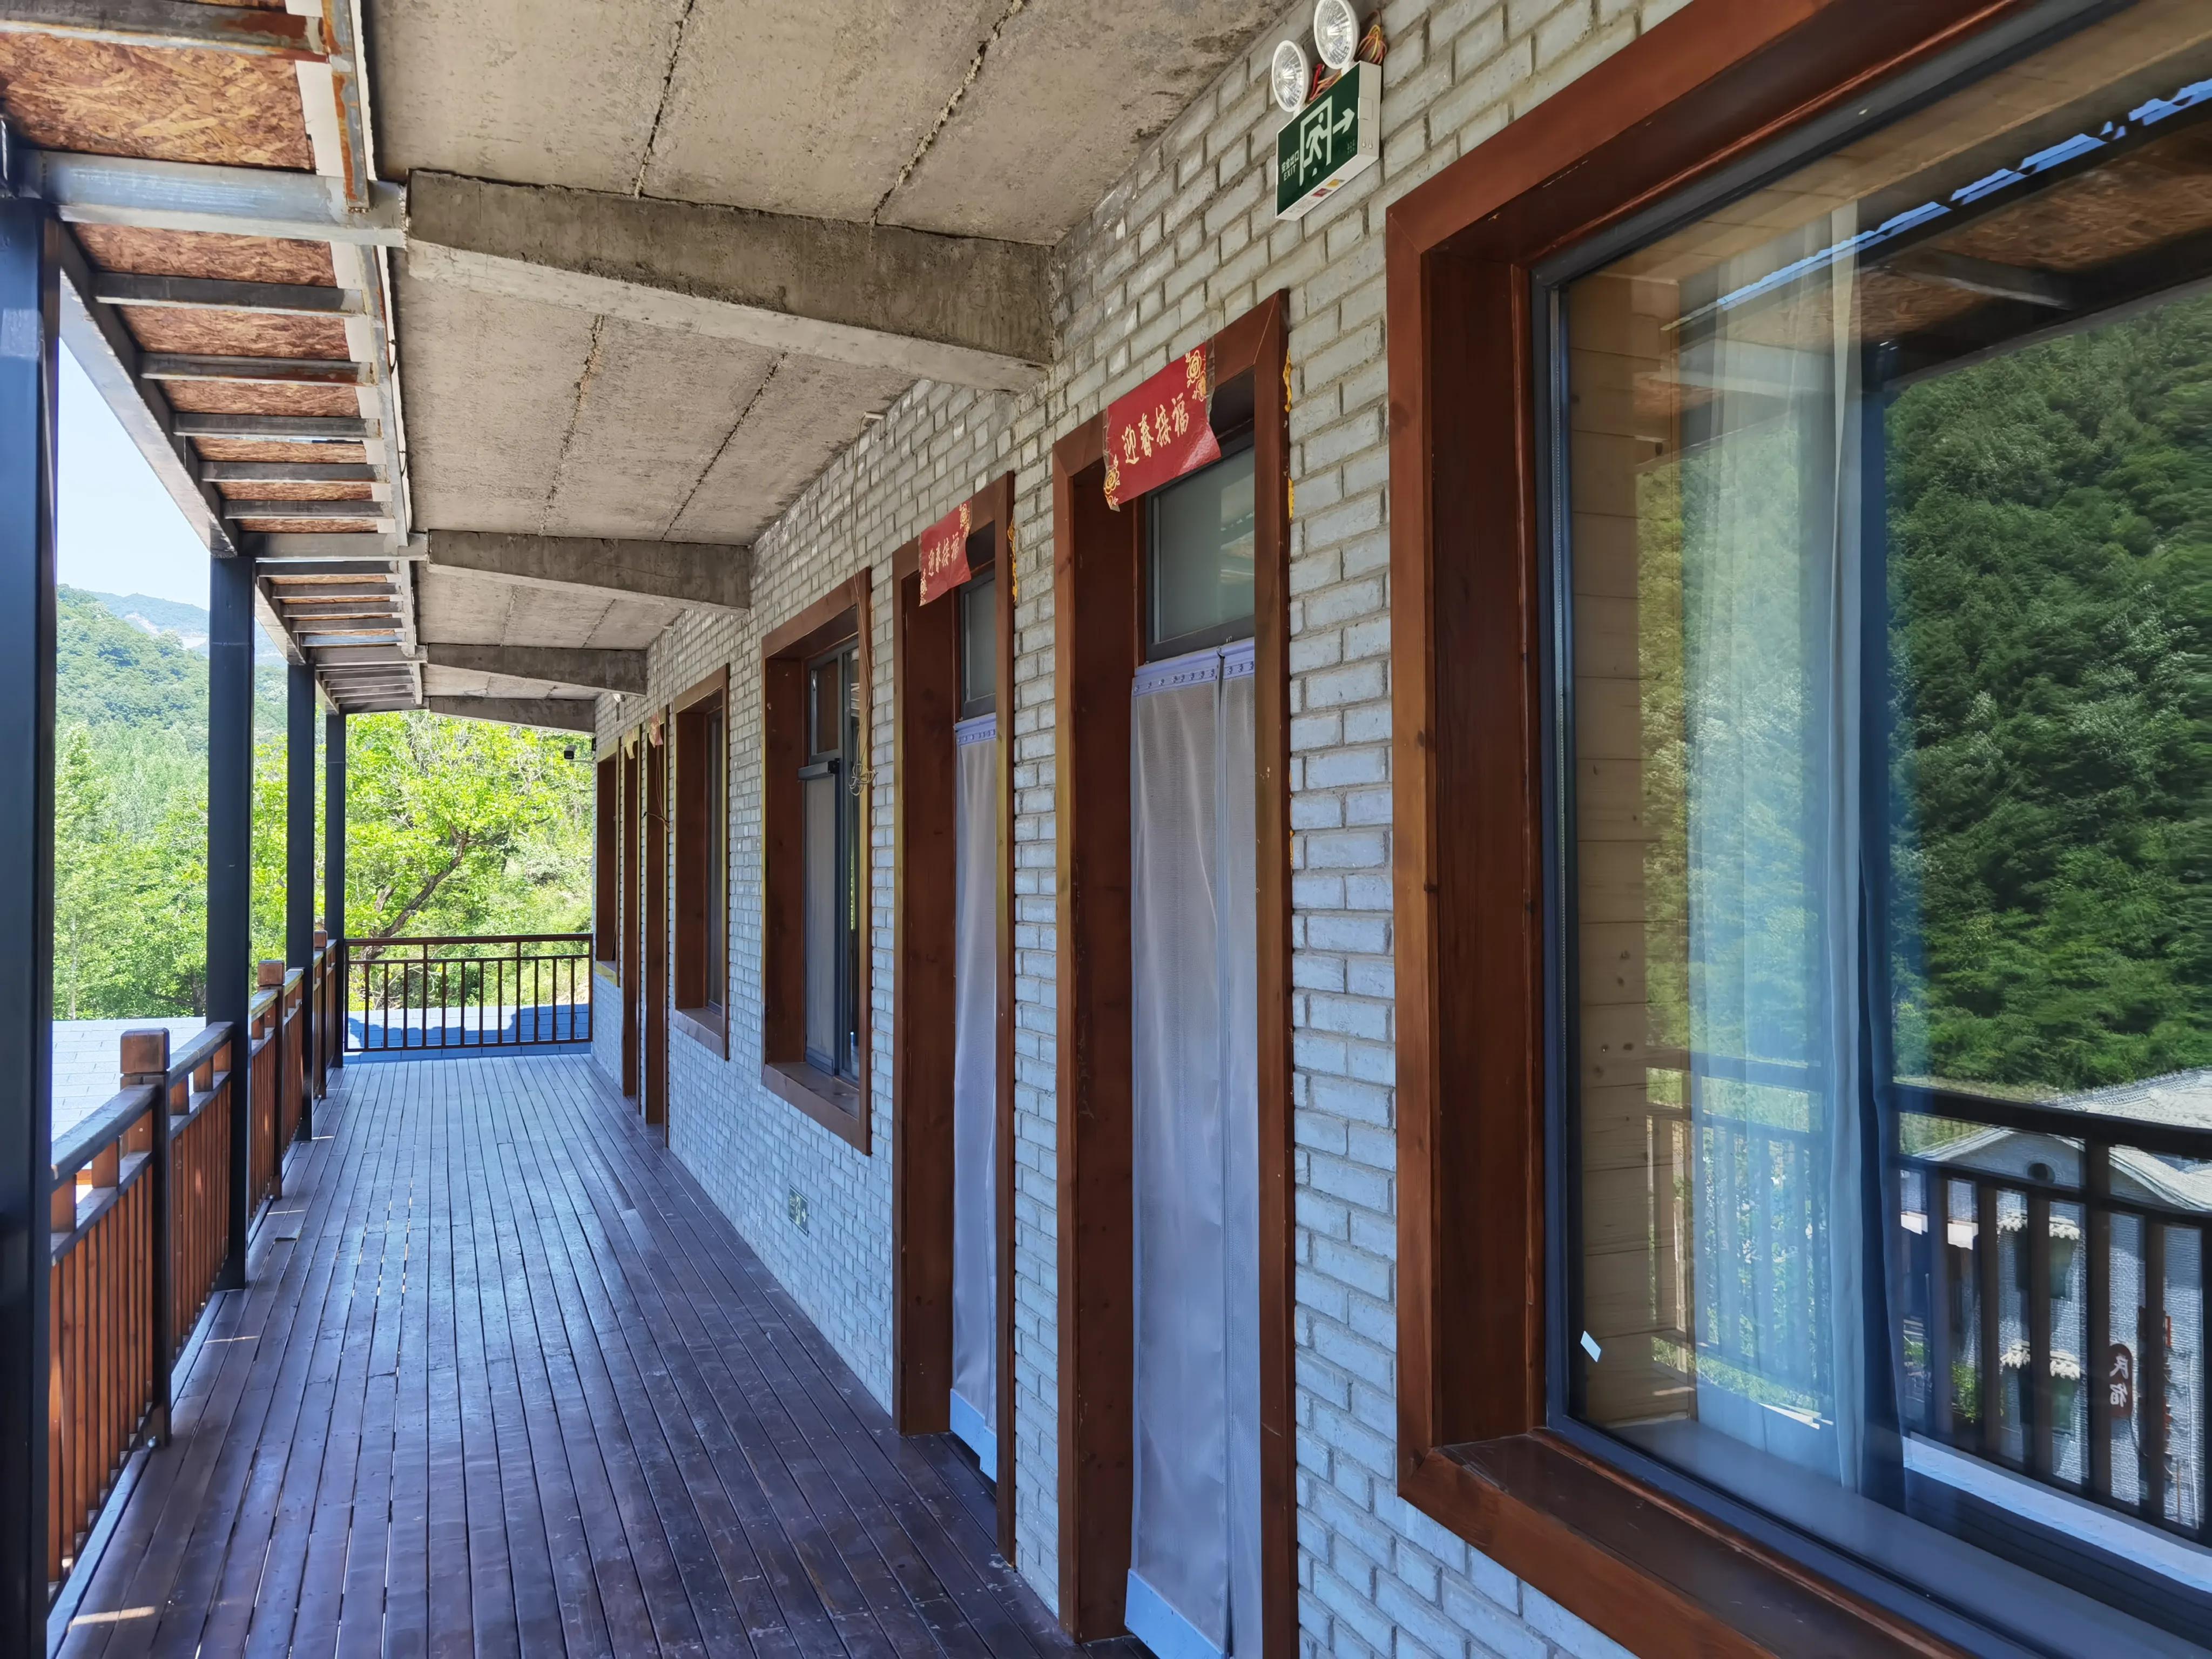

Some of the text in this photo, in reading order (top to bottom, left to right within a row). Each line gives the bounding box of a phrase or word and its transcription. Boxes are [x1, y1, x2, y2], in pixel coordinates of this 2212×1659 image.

[1282, 150, 1299, 174] 安全出口
[1284, 164, 1297, 181] EXIT
[1122, 393, 1189, 464] 迎春接福
